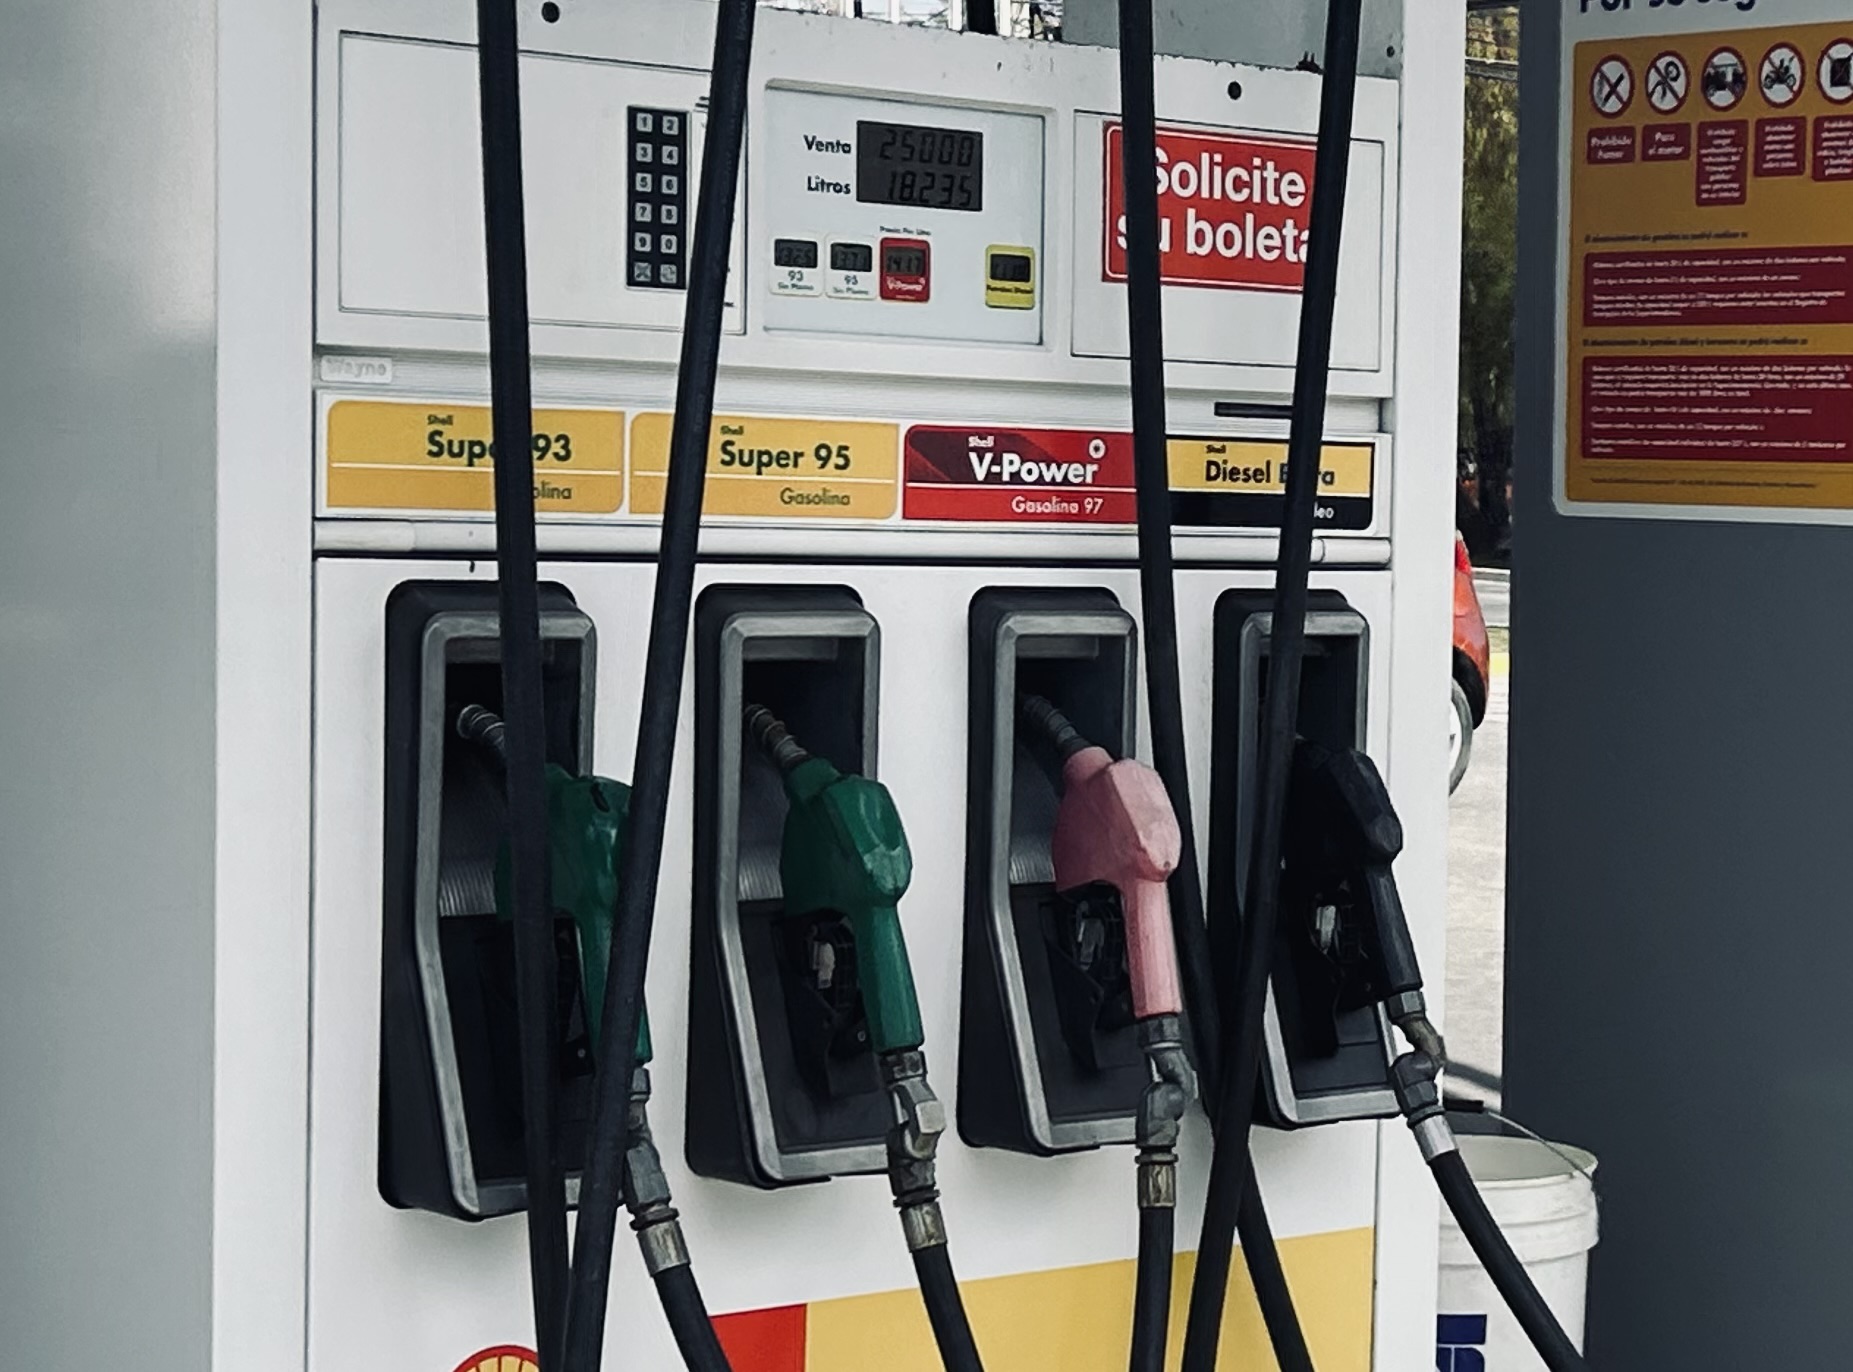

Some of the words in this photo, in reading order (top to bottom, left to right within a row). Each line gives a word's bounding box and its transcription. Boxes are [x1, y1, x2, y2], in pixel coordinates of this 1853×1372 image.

[641, 117, 649, 130] 1
[666, 118, 674, 132] 2
[803, 135, 852, 154] Venta
[879, 128, 974, 167] 25000
[640, 147, 649, 159] 3
[665, 149, 675, 162] 4
[639, 176, 648, 188] 5
[665, 179, 674, 191] 6
[807, 176, 851, 195] Litros
[638, 205, 647, 218] 7
[665, 207, 674, 220] 8
[638, 236, 647, 249] 9
[664, 238, 673, 251] 0
[788, 270, 804, 282] 93
[427, 414, 453, 426] Shell
[720, 424, 744, 436] Shell
[531, 433, 572, 462] 93
[968, 435, 995, 448] Shell
[720, 439, 804, 476] Super
[814, 443, 851, 471] 95
[968, 451, 1099, 484] V-Power
[1205, 459, 1271, 484] Diesel
[780, 486, 851, 506] Gasolina
[1011, 496, 1080, 513] Gasolina
[1084, 498, 1103, 514] 97
